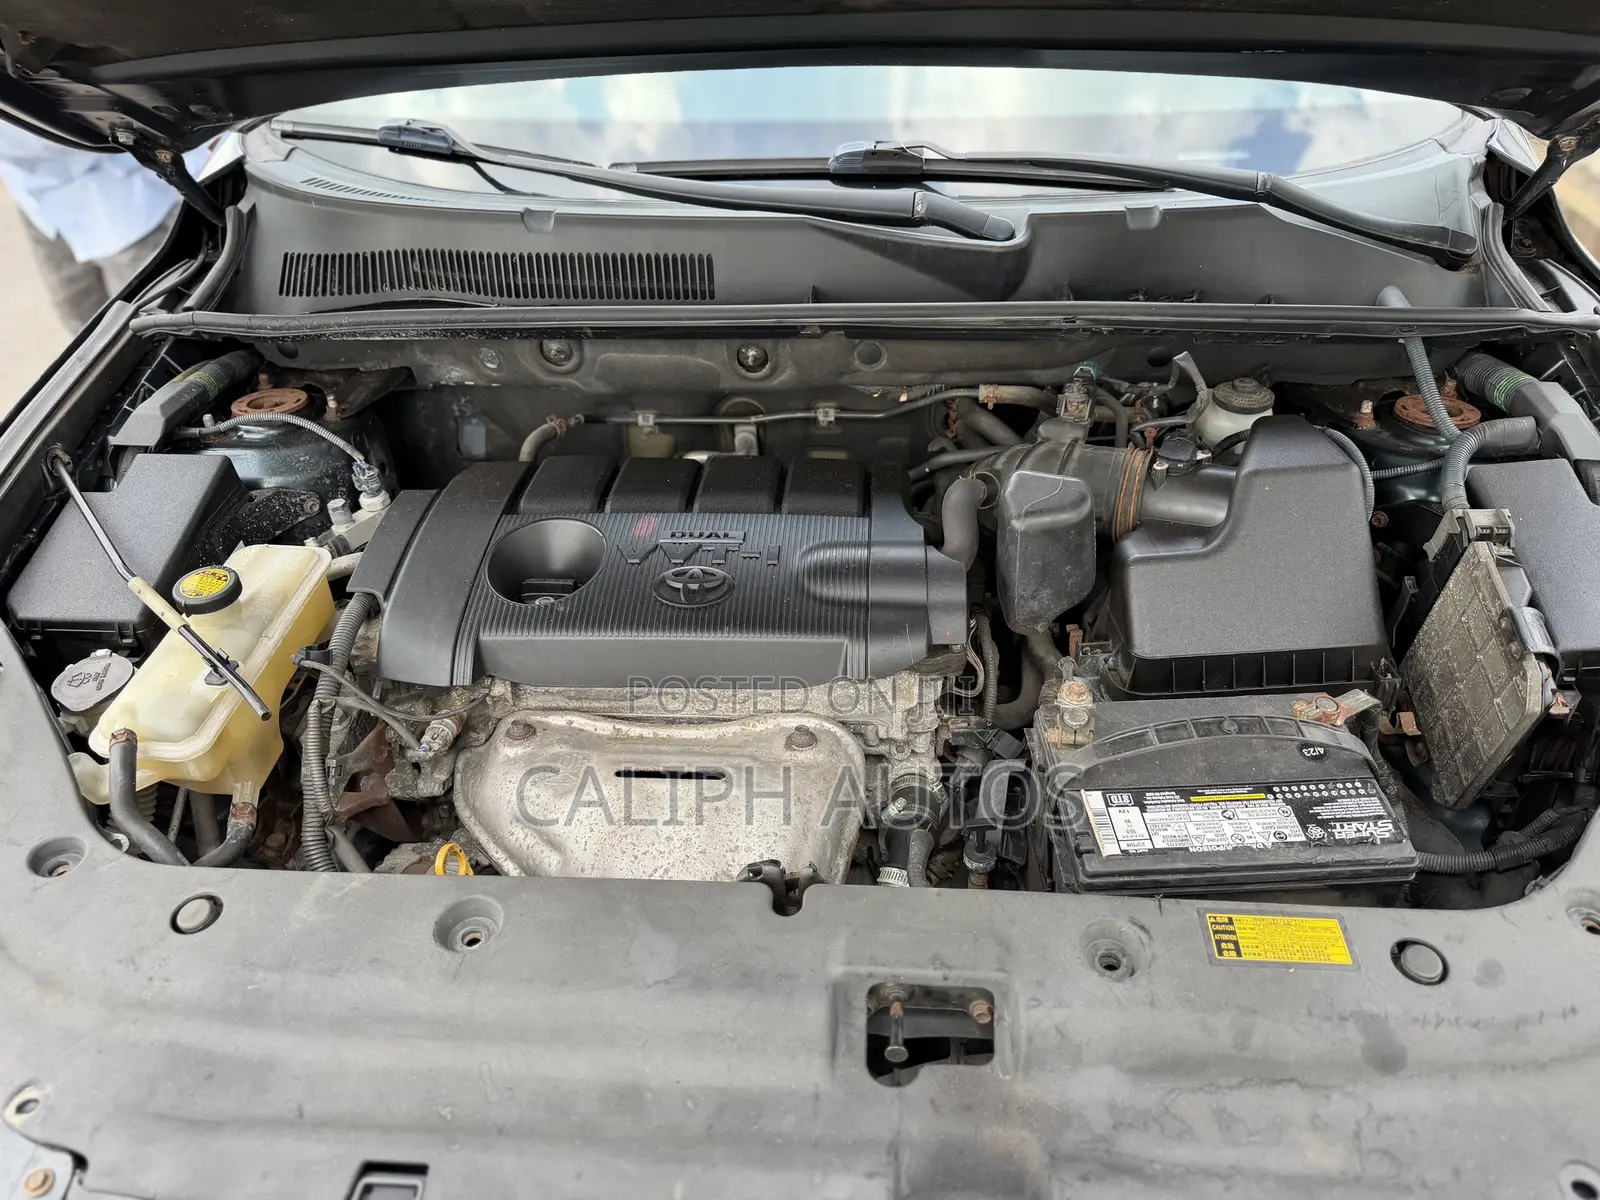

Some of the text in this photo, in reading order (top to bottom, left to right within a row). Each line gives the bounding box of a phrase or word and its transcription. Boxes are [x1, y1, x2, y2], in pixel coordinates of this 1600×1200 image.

[671, 531, 738, 540] DUAL
[1302, 747, 1324, 757] 4/23
[1110, 795, 1131, 804] STD
[1331, 820, 1393, 832] START
[1334, 830, 1390, 839] SUPER
